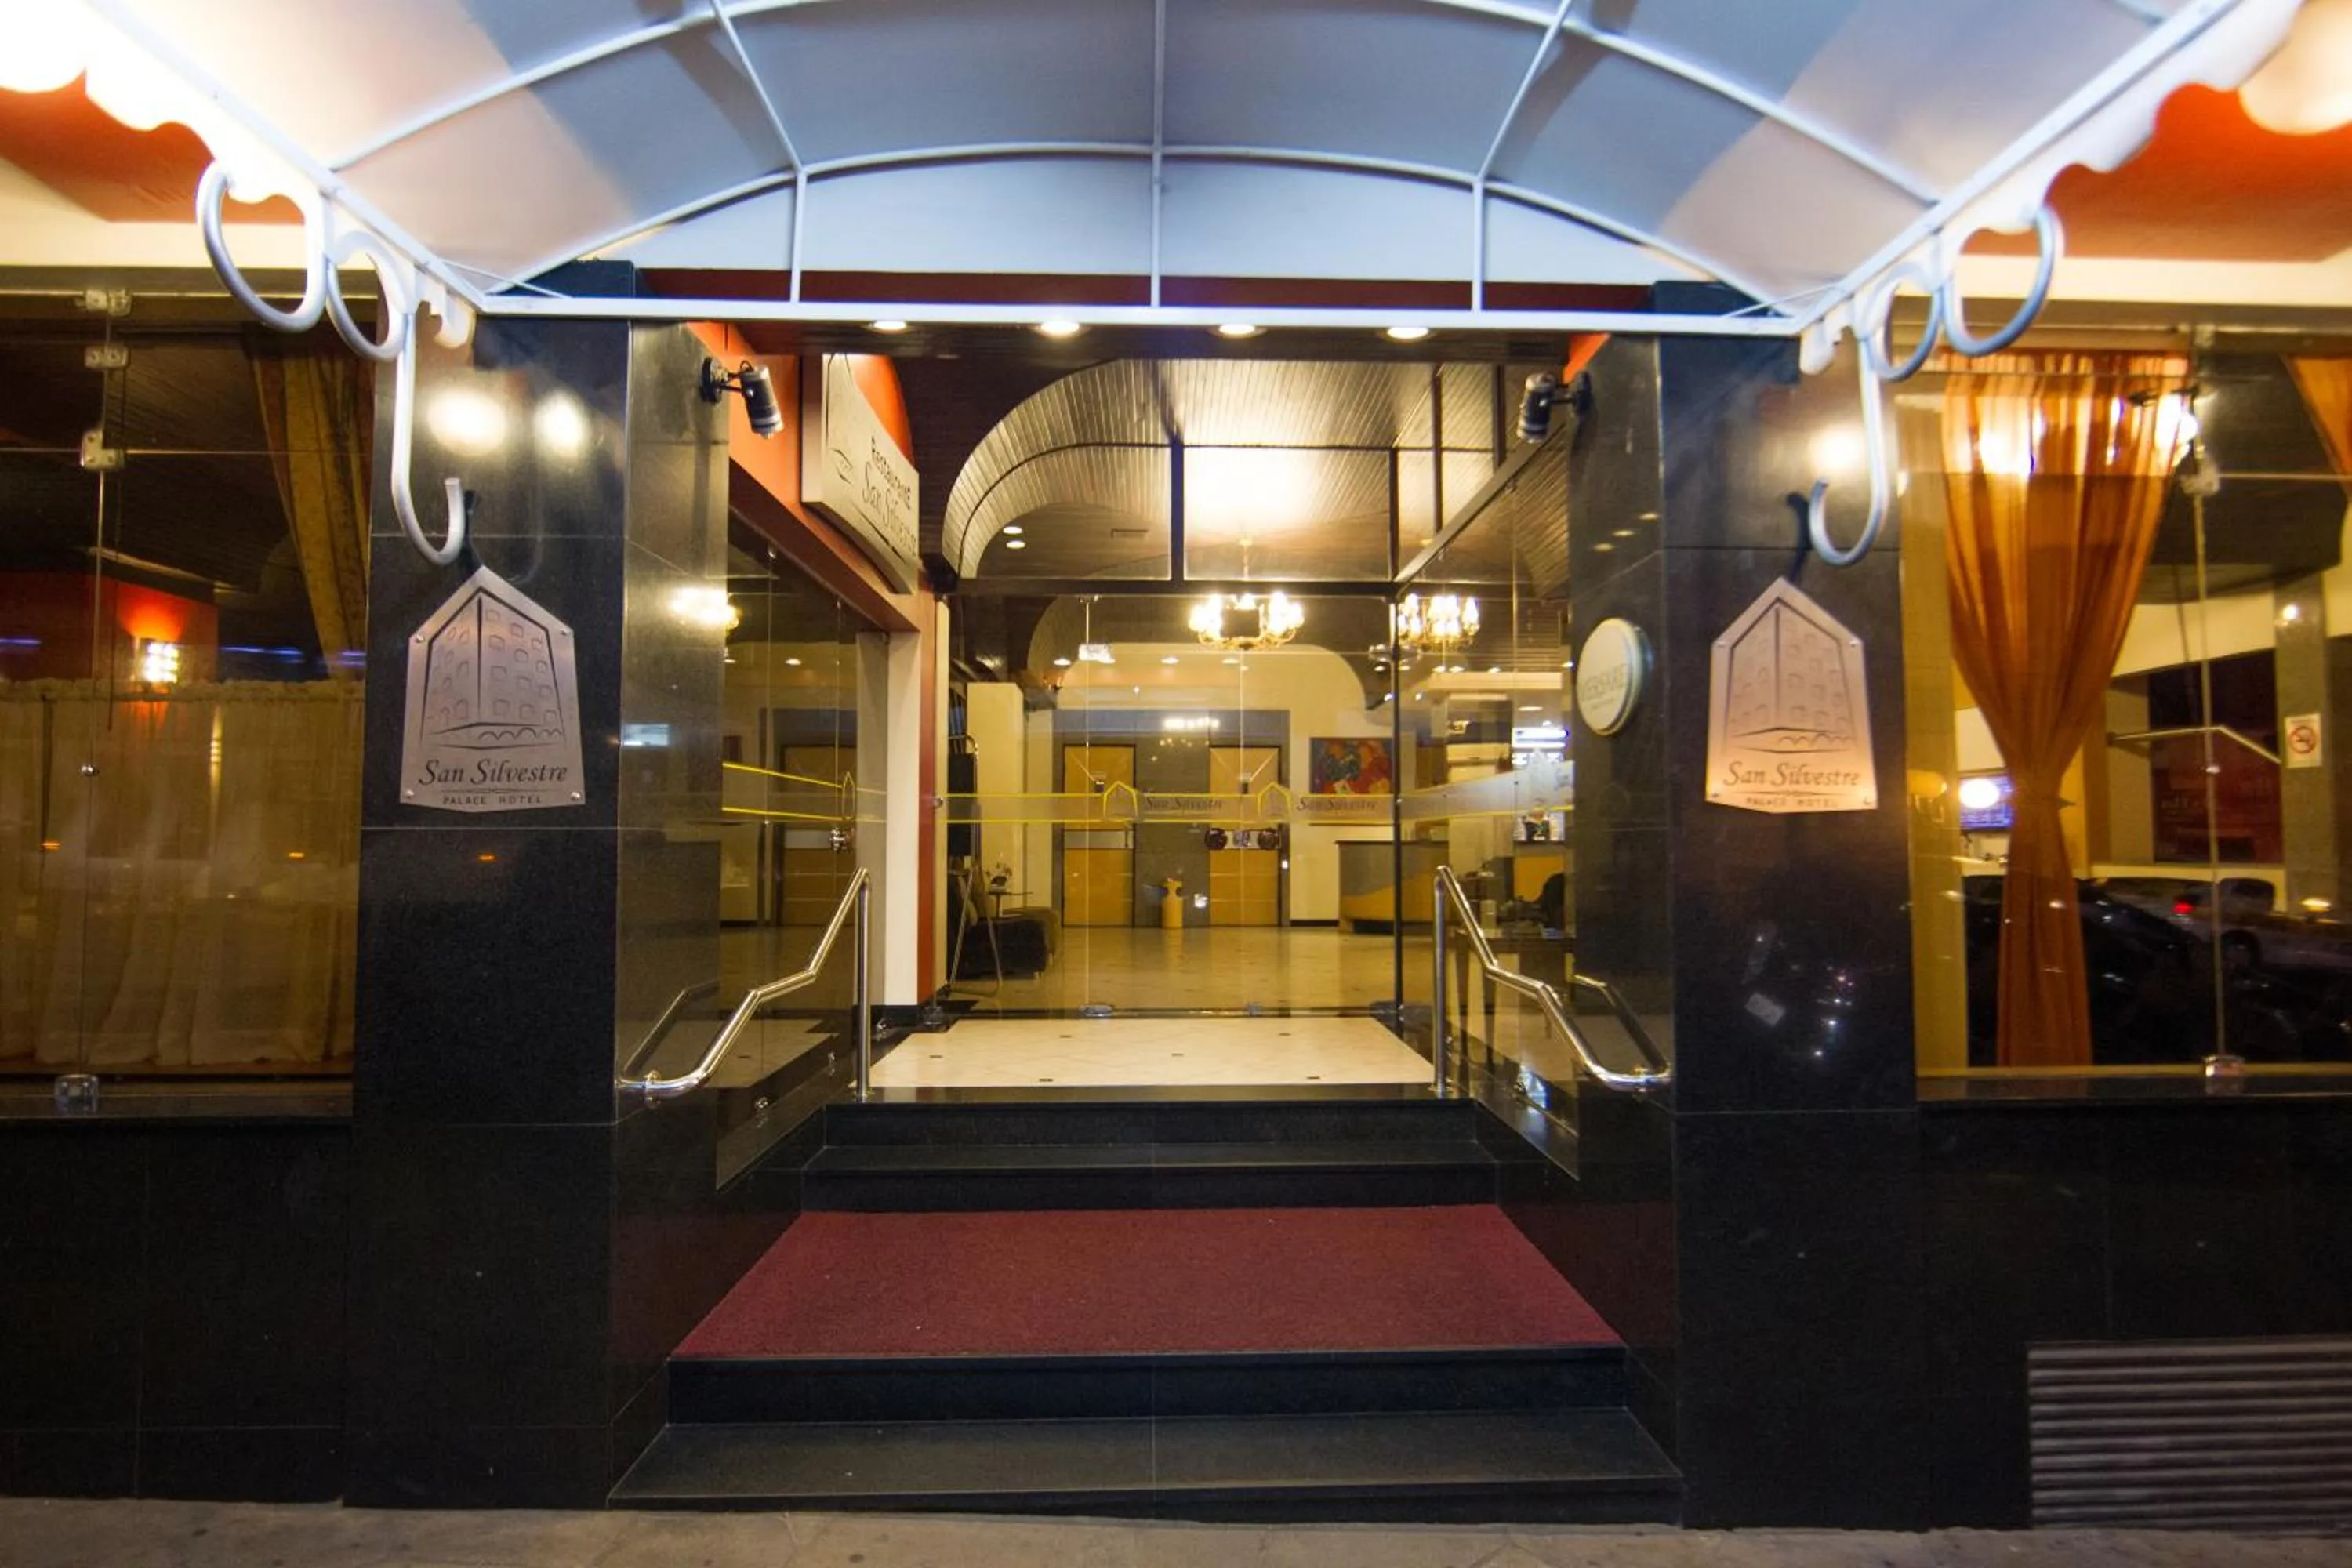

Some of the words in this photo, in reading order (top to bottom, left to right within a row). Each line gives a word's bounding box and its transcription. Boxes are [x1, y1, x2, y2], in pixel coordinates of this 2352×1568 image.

[419, 759, 464, 785] San
[470, 758, 568, 785] Silvestre
[1723, 760, 1766, 786] San
[1771, 762, 1860, 786] Silvestre
[443, 795, 487, 805] PALACE
[499, 795, 543, 804] HOTEL
